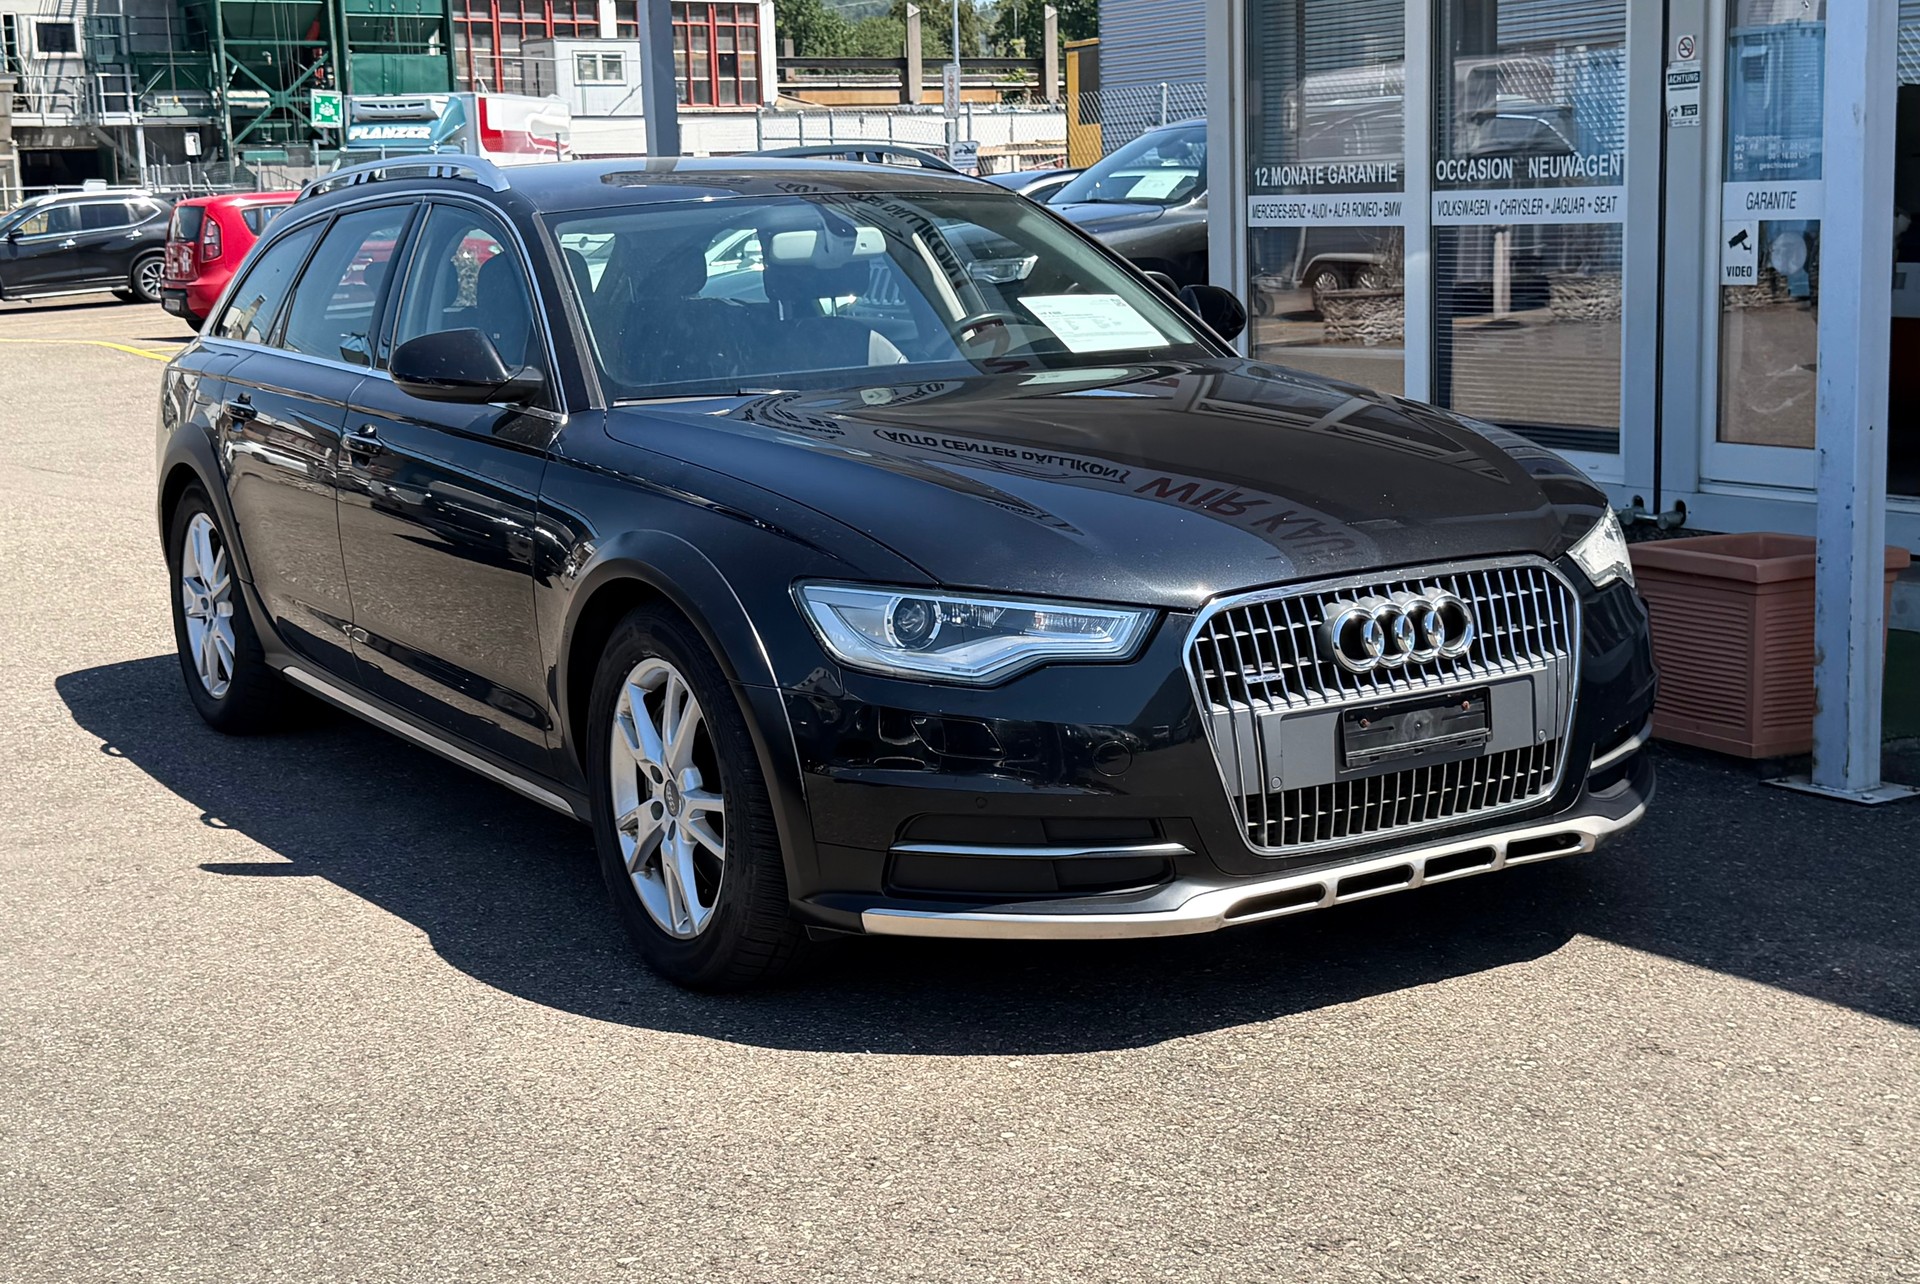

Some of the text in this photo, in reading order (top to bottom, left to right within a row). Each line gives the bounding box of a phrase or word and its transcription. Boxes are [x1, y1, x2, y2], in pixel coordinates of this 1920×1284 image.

[1669, 73, 1699, 84] ACHTUNG
[348, 126, 432, 140] PLANZER
[1255, 162, 1398, 187] 12 MONATE GARANTIE
[1435, 154, 1621, 182] OCCASION NEUWAGEN
[1438, 196, 1618, 217] VOLKSWAGEN CHRYSLER JAGUAR SEAT
[1746, 191, 1797, 210] GARANTIE
[1252, 201, 1403, 219] MERCEDES-BENZ AUDI ALFA ROMEO BMW
[1726, 265, 1752, 278] VIDEO
